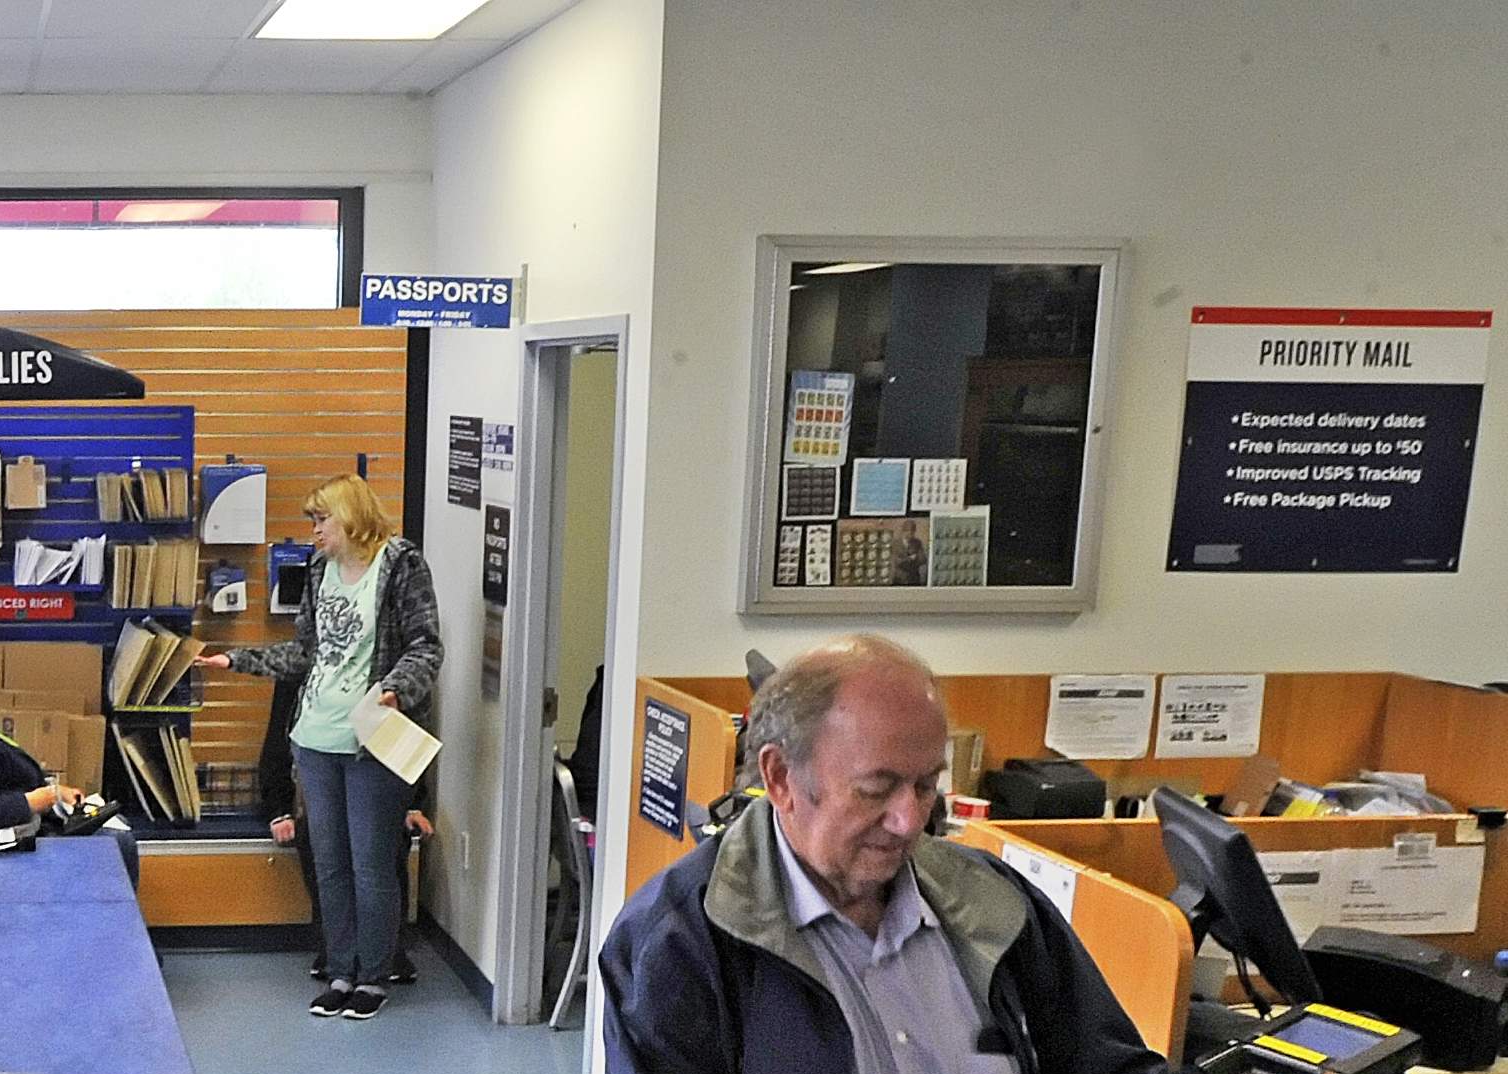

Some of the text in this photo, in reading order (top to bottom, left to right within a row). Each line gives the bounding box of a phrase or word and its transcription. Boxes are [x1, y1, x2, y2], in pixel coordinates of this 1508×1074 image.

[365, 278, 508, 305] PASSPORTS
[1259, 340, 1413, 368] PRIORITY MAIL
[1241, 412, 1426, 431] Expected delivery dates
[1238, 439, 1272, 454] Free
[1277, 440, 1348, 455] insurance
[1351, 443, 1372, 458] up
[1375, 441, 1392, 454] to
[1236, 466, 1421, 484] Improved USPS Tracking
[1232, 492, 1391, 509] Free Package Pickup
[29, 598, 64, 609] RIGHT
